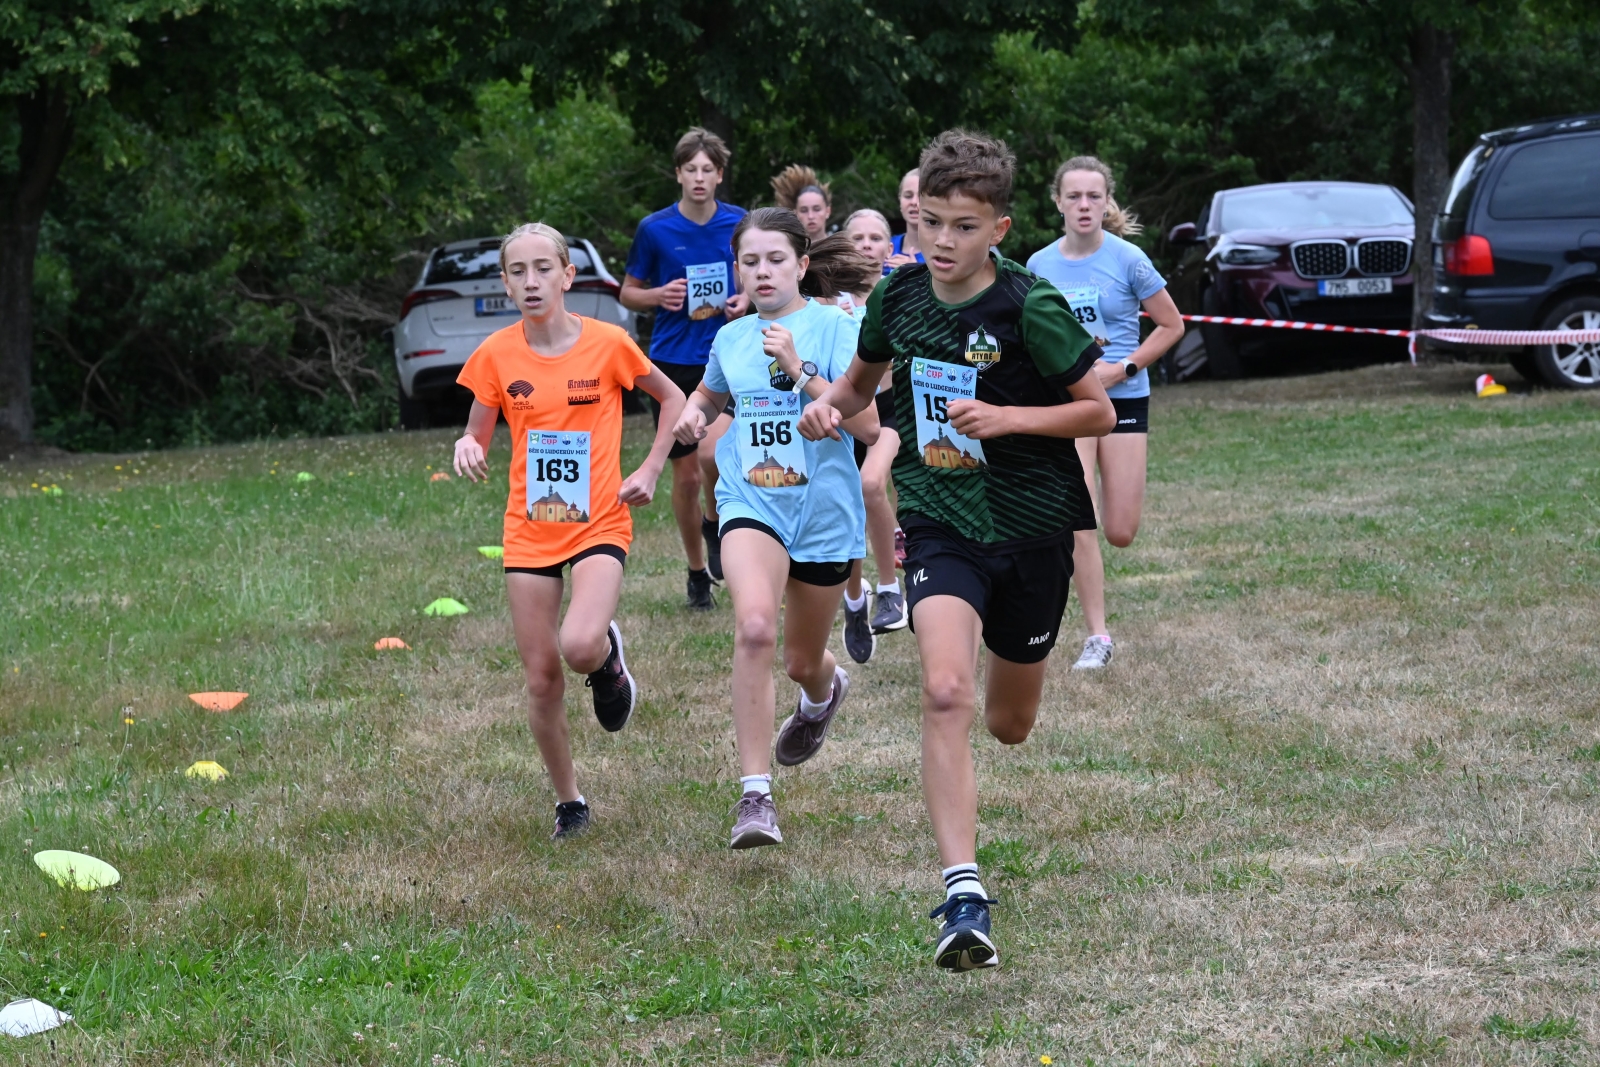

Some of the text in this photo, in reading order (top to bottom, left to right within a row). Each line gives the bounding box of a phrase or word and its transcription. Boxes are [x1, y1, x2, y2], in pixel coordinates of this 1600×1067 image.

[692, 281, 724, 298] 250
[1073, 305, 1097, 324] 43
[926, 369, 943, 379] CUP
[568, 394, 600, 402] MARATON
[753, 400, 769, 408] CUP
[923, 393, 954, 424] 15
[749, 420, 792, 447] 156
[536, 458, 579, 483] 163
[1028, 631, 1050, 645] JAKO
